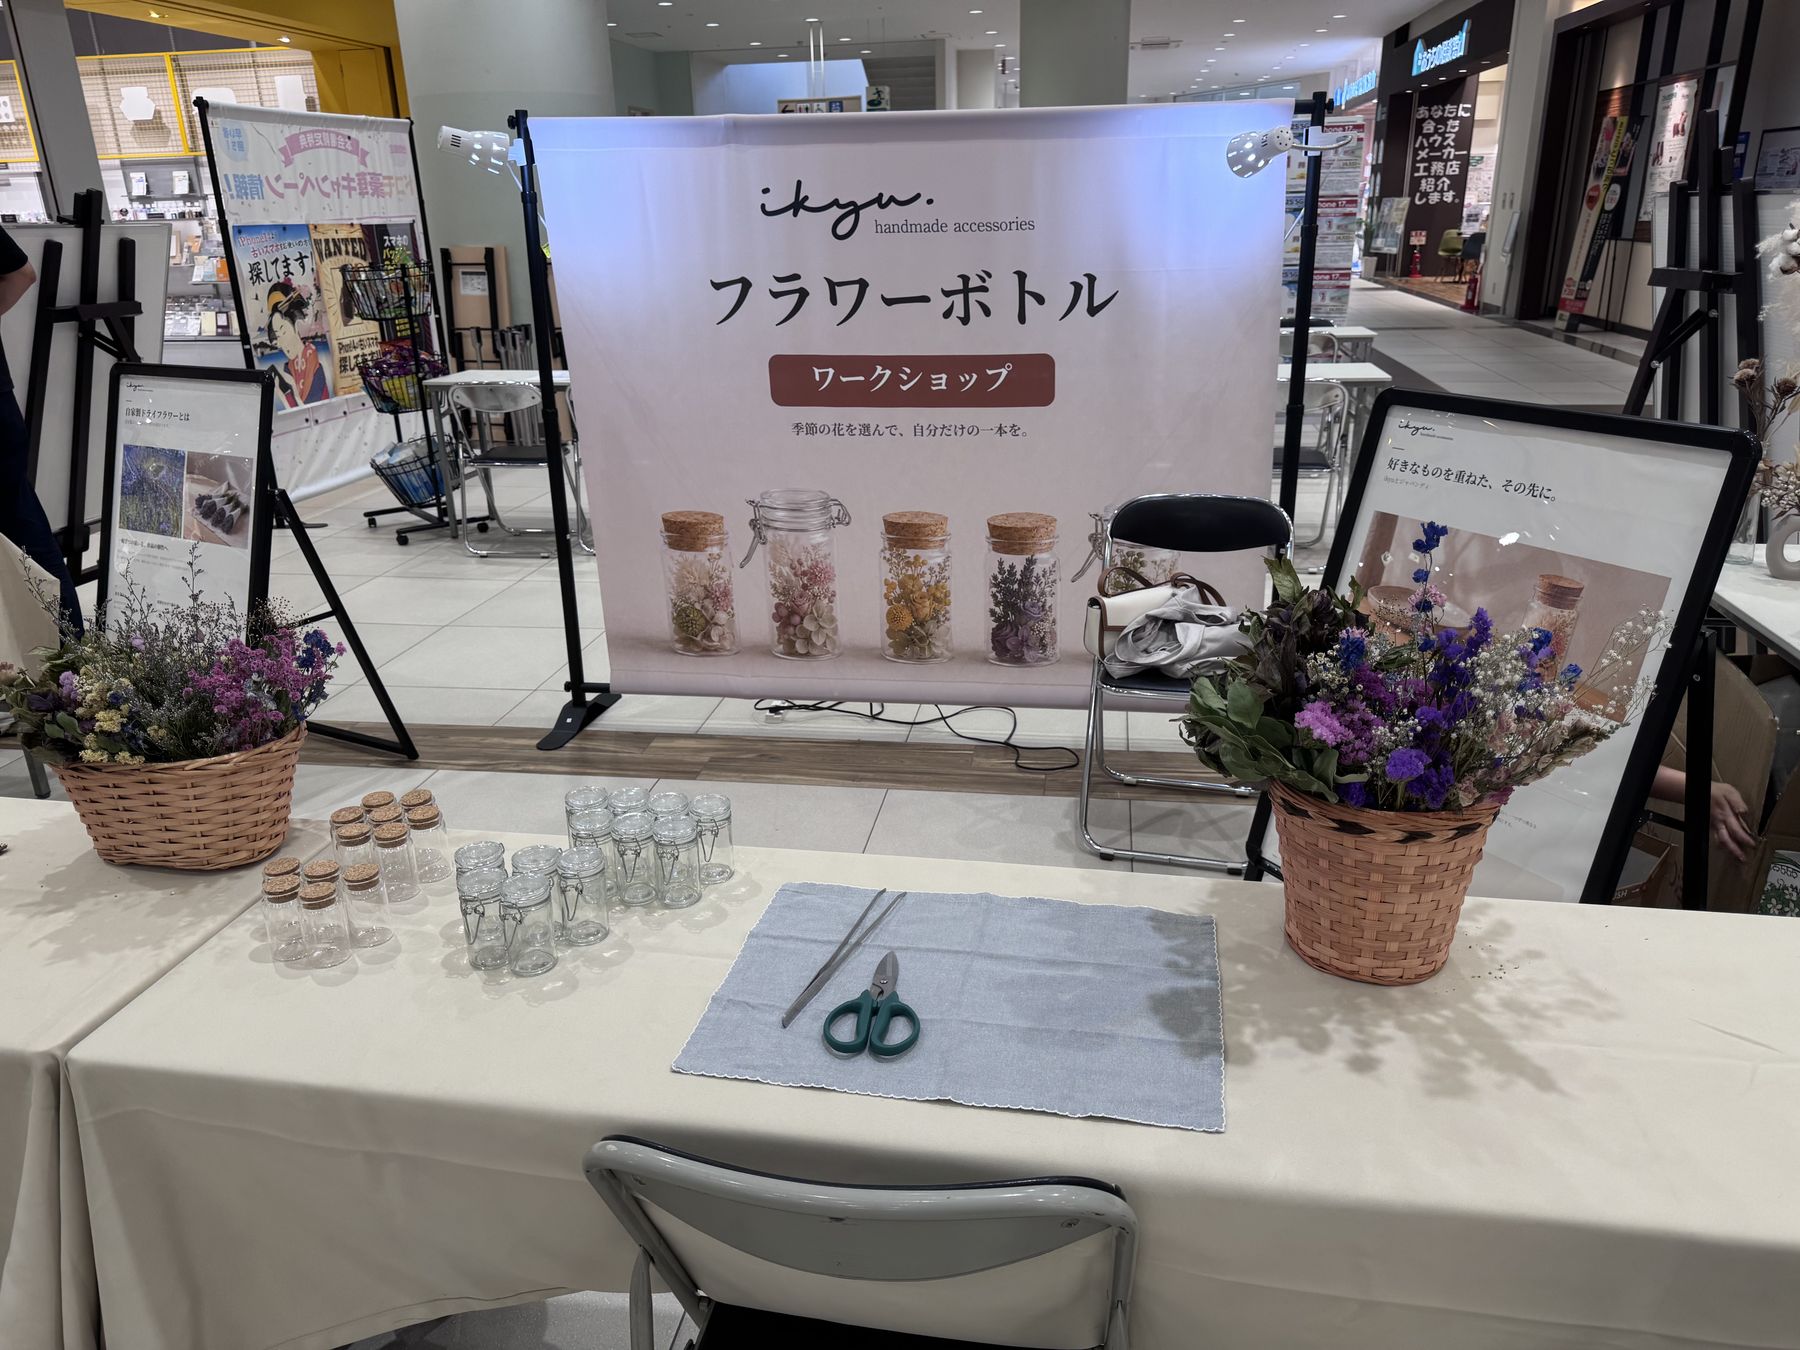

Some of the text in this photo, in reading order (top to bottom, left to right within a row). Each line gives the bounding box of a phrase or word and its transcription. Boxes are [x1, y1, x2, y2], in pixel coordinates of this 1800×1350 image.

[1416, 103, 1472, 119] あなたに
[1422, 119, 1460, 133] 合った
[1415, 133, 1456, 148] ハウス
[1416, 146, 1468, 160] メーカー
[1414, 160, 1461, 177] 工務店
[1419, 177, 1451, 192] 紹介
[1414, 190, 1460, 205] します。
[874, 217, 1035, 234] handmade accessories
[313, 237, 367, 264] WANTED
[709, 268, 1120, 327] フラワーボトル
[812, 362, 1013, 393] ワークショップ
[125, 407, 190, 421] 自家製ドライフラワーとは
[790, 422, 1029, 438] 季節の花を選んで、自分だけの一本を。
[1386, 457, 1557, 502] 好きなものを重ねた、その先に。
